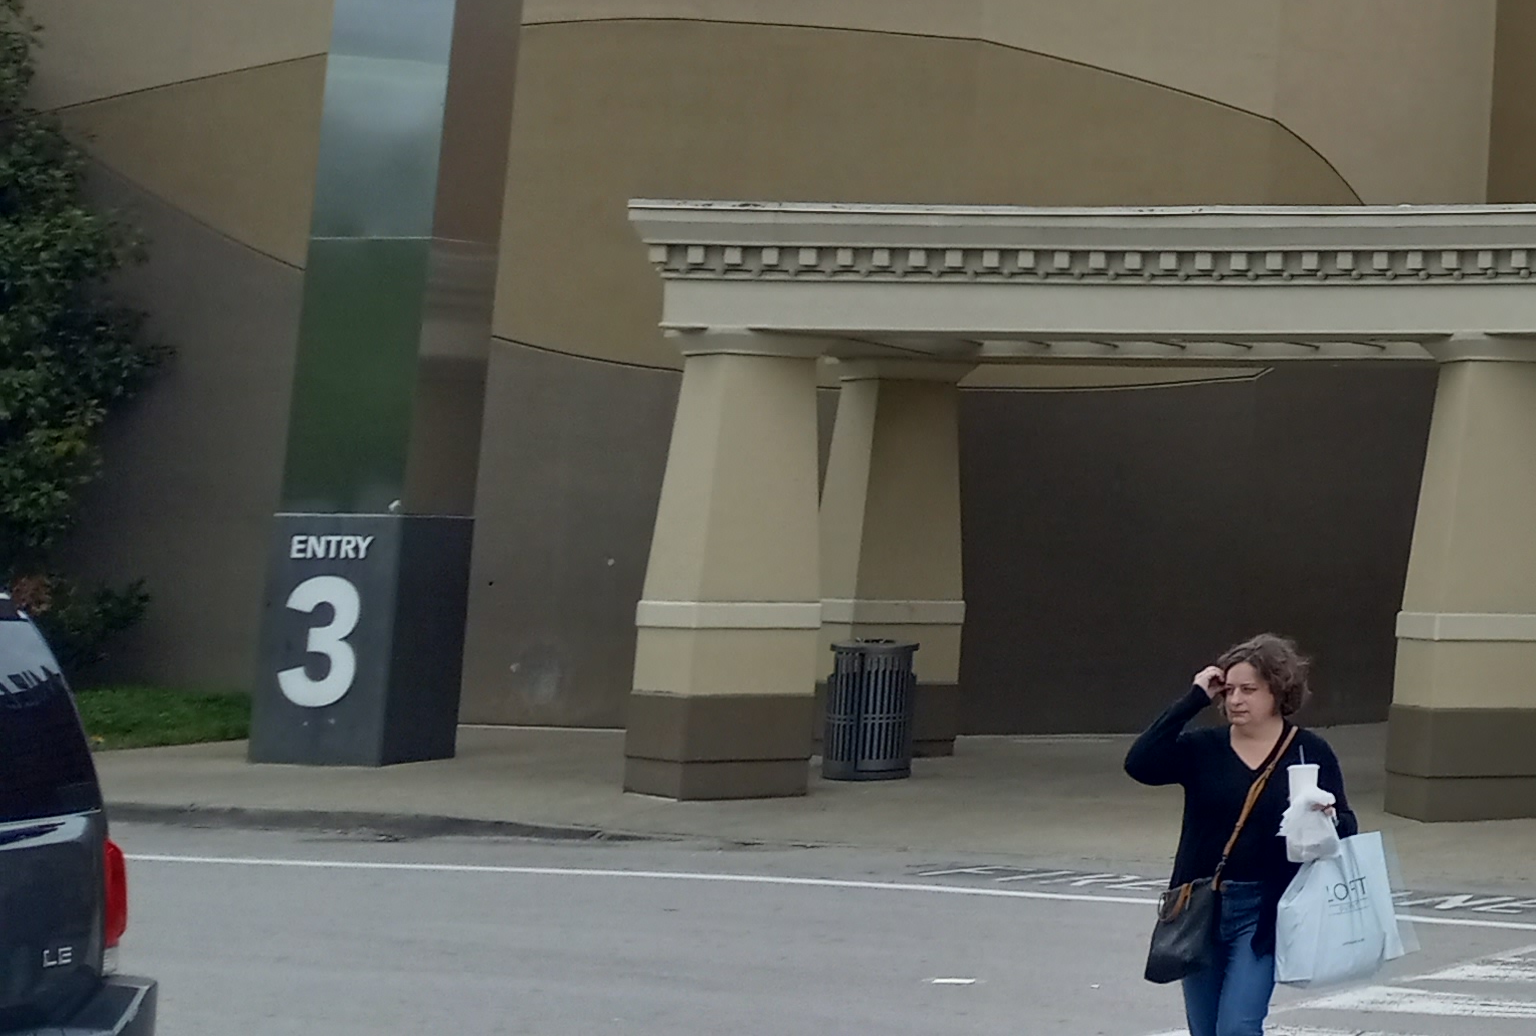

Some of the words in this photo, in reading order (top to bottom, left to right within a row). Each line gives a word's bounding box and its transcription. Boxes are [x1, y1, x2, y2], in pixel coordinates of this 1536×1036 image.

[290, 535, 374, 559] ENTRY
[277, 575, 361, 707] 3
[918, 865, 1170, 891] FIRE
[42, 946, 73, 968] LE
